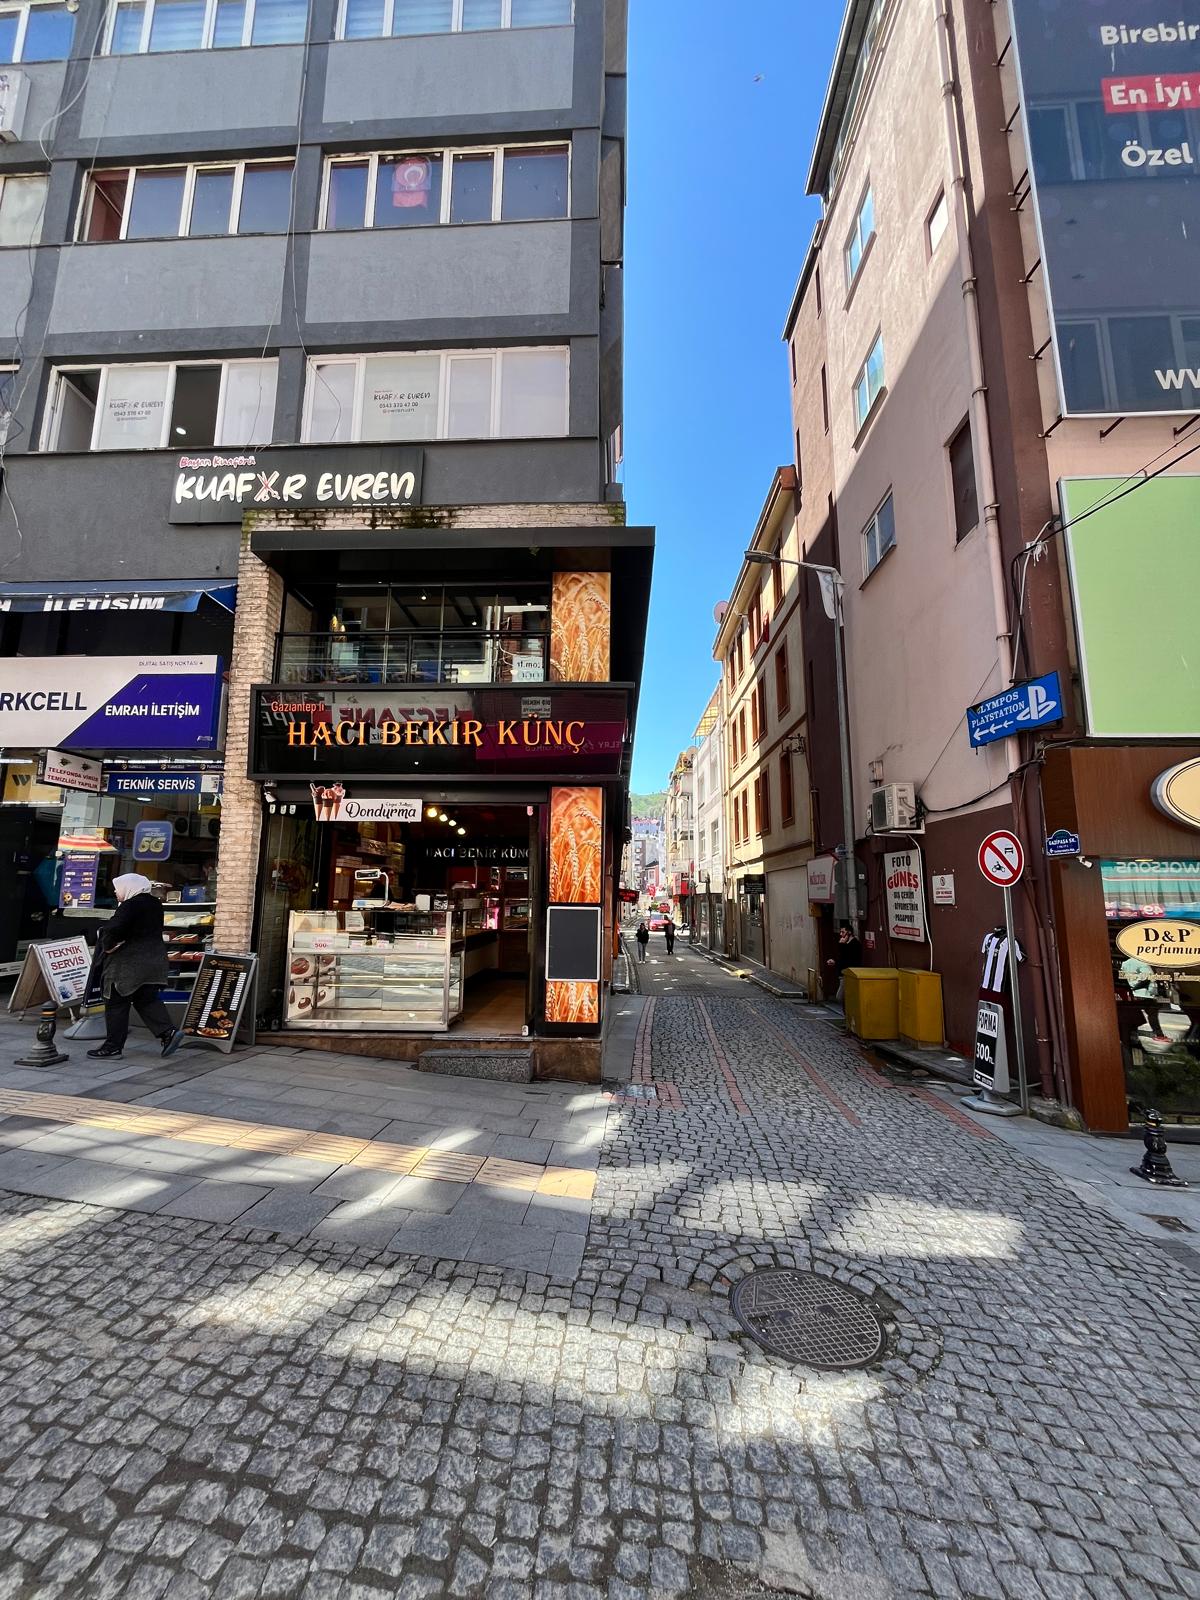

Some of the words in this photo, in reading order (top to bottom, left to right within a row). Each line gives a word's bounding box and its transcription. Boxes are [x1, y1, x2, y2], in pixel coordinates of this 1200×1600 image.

[1100, 21, 1200, 45] Birebir
[1110, 84, 1148, 106] En
[1154, 77, 1192, 107] İyi
[1121, 140, 1194, 167] Özel
[316, 471, 415, 502] EVREN
[0, 691, 87, 711] RKCELL
[105, 704, 148, 717] EMRAH
[151, 701, 200, 719] İLETİŞİM
[977, 691, 1019, 714] LYMPOS
[971, 701, 1025, 728] PLAYSTATION
[287, 720, 368, 746] HACI
[381, 717, 483, 747] BEKİR
[498, 712, 585, 754] KÜNÇ
[117, 776, 155, 790] TEKNİK
[157, 776, 196, 790] SERVİS
[345, 801, 417, 819] Dondurma
[138, 836, 167, 853] 5G
[891, 855, 912, 868] FOTO
[887, 869, 919, 892] GÜNEŞ
[46, 945, 82, 959] TEKNİK
[51, 955, 85, 970] SERVİS
